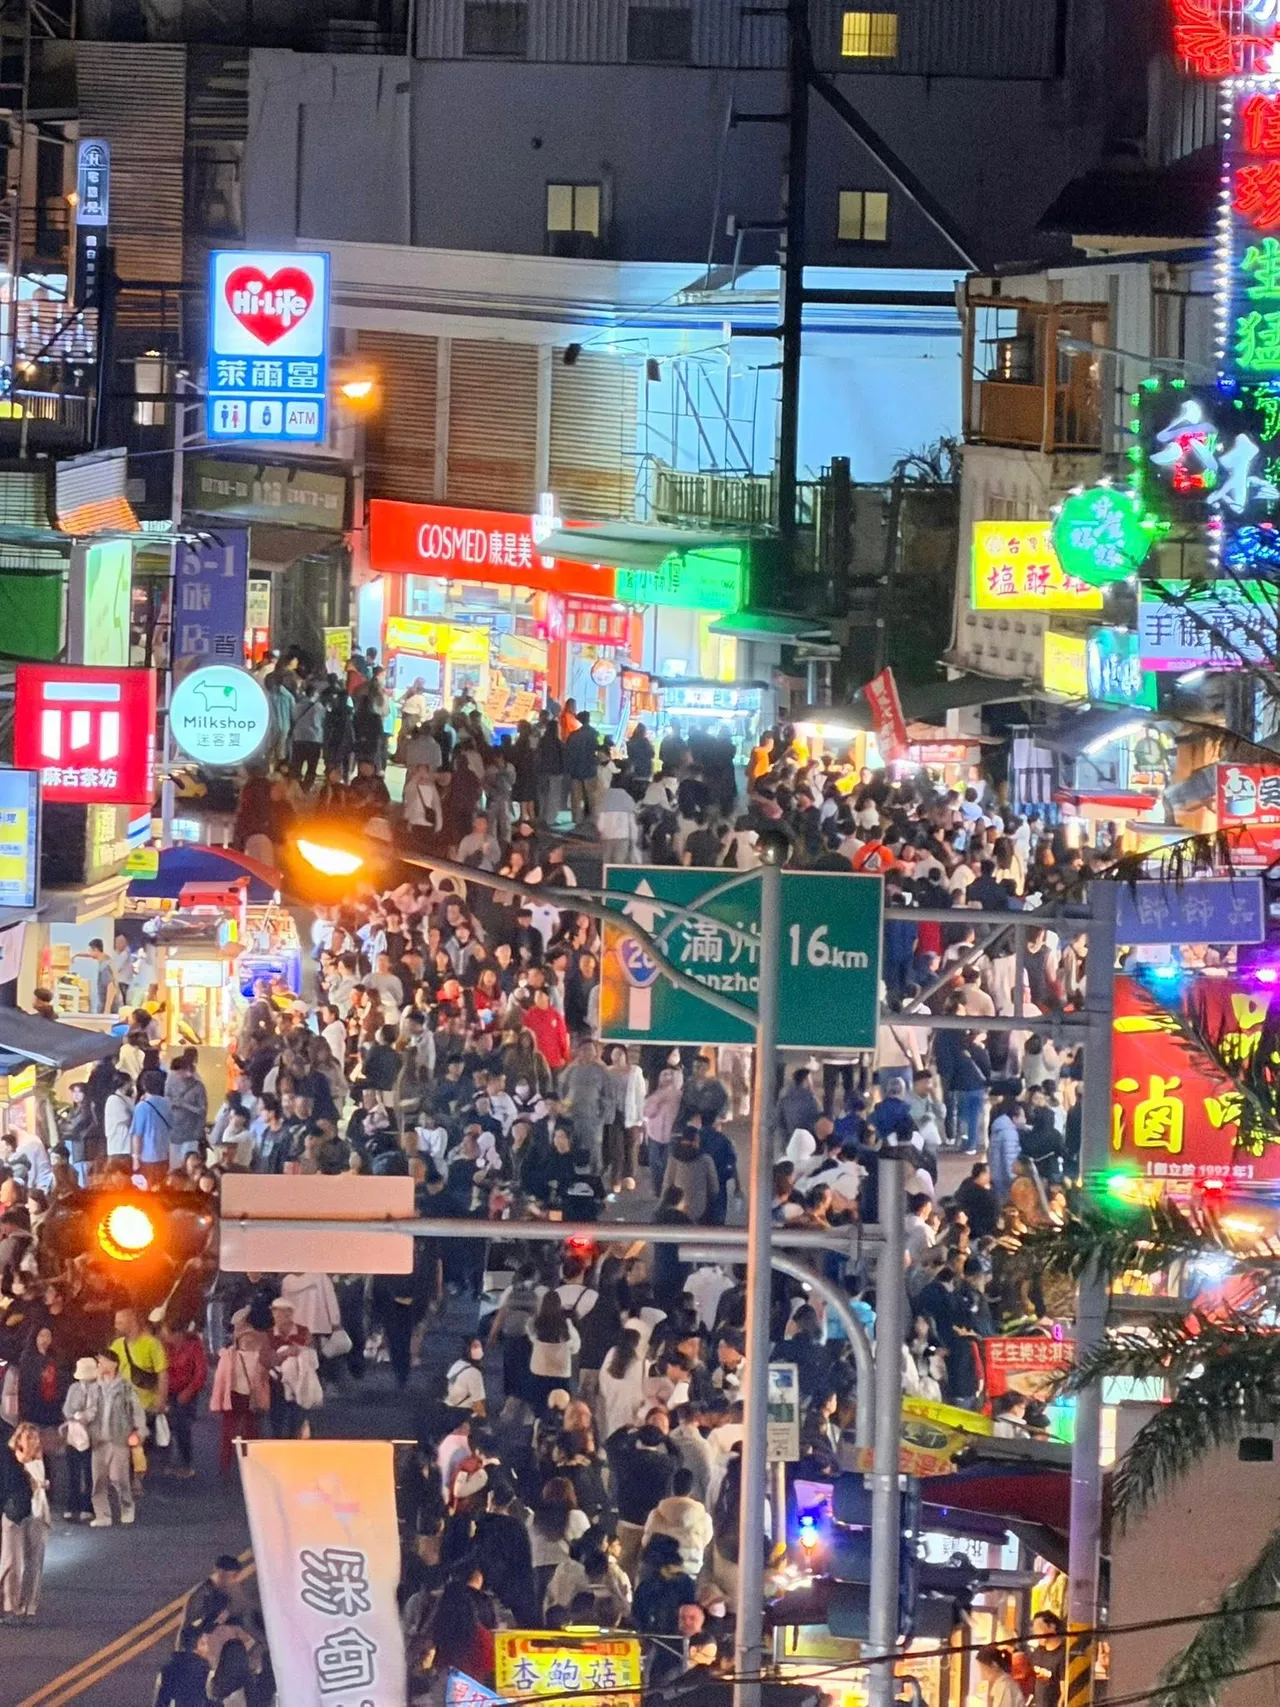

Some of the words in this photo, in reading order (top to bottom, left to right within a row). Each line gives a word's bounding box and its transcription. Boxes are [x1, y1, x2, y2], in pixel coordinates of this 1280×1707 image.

[216, 360, 319, 388] 萊爾富
[288, 409, 316, 426] ATM
[417, 523, 488, 562] COSMED
[489, 531, 532, 570] 康是美
[184, 715, 256, 734] Milkshop
[196, 733, 242, 748] 迷客夏
[41, 766, 118, 788] 麻古茶坊
[511, 1657, 618, 1690] 杏鮑菇
